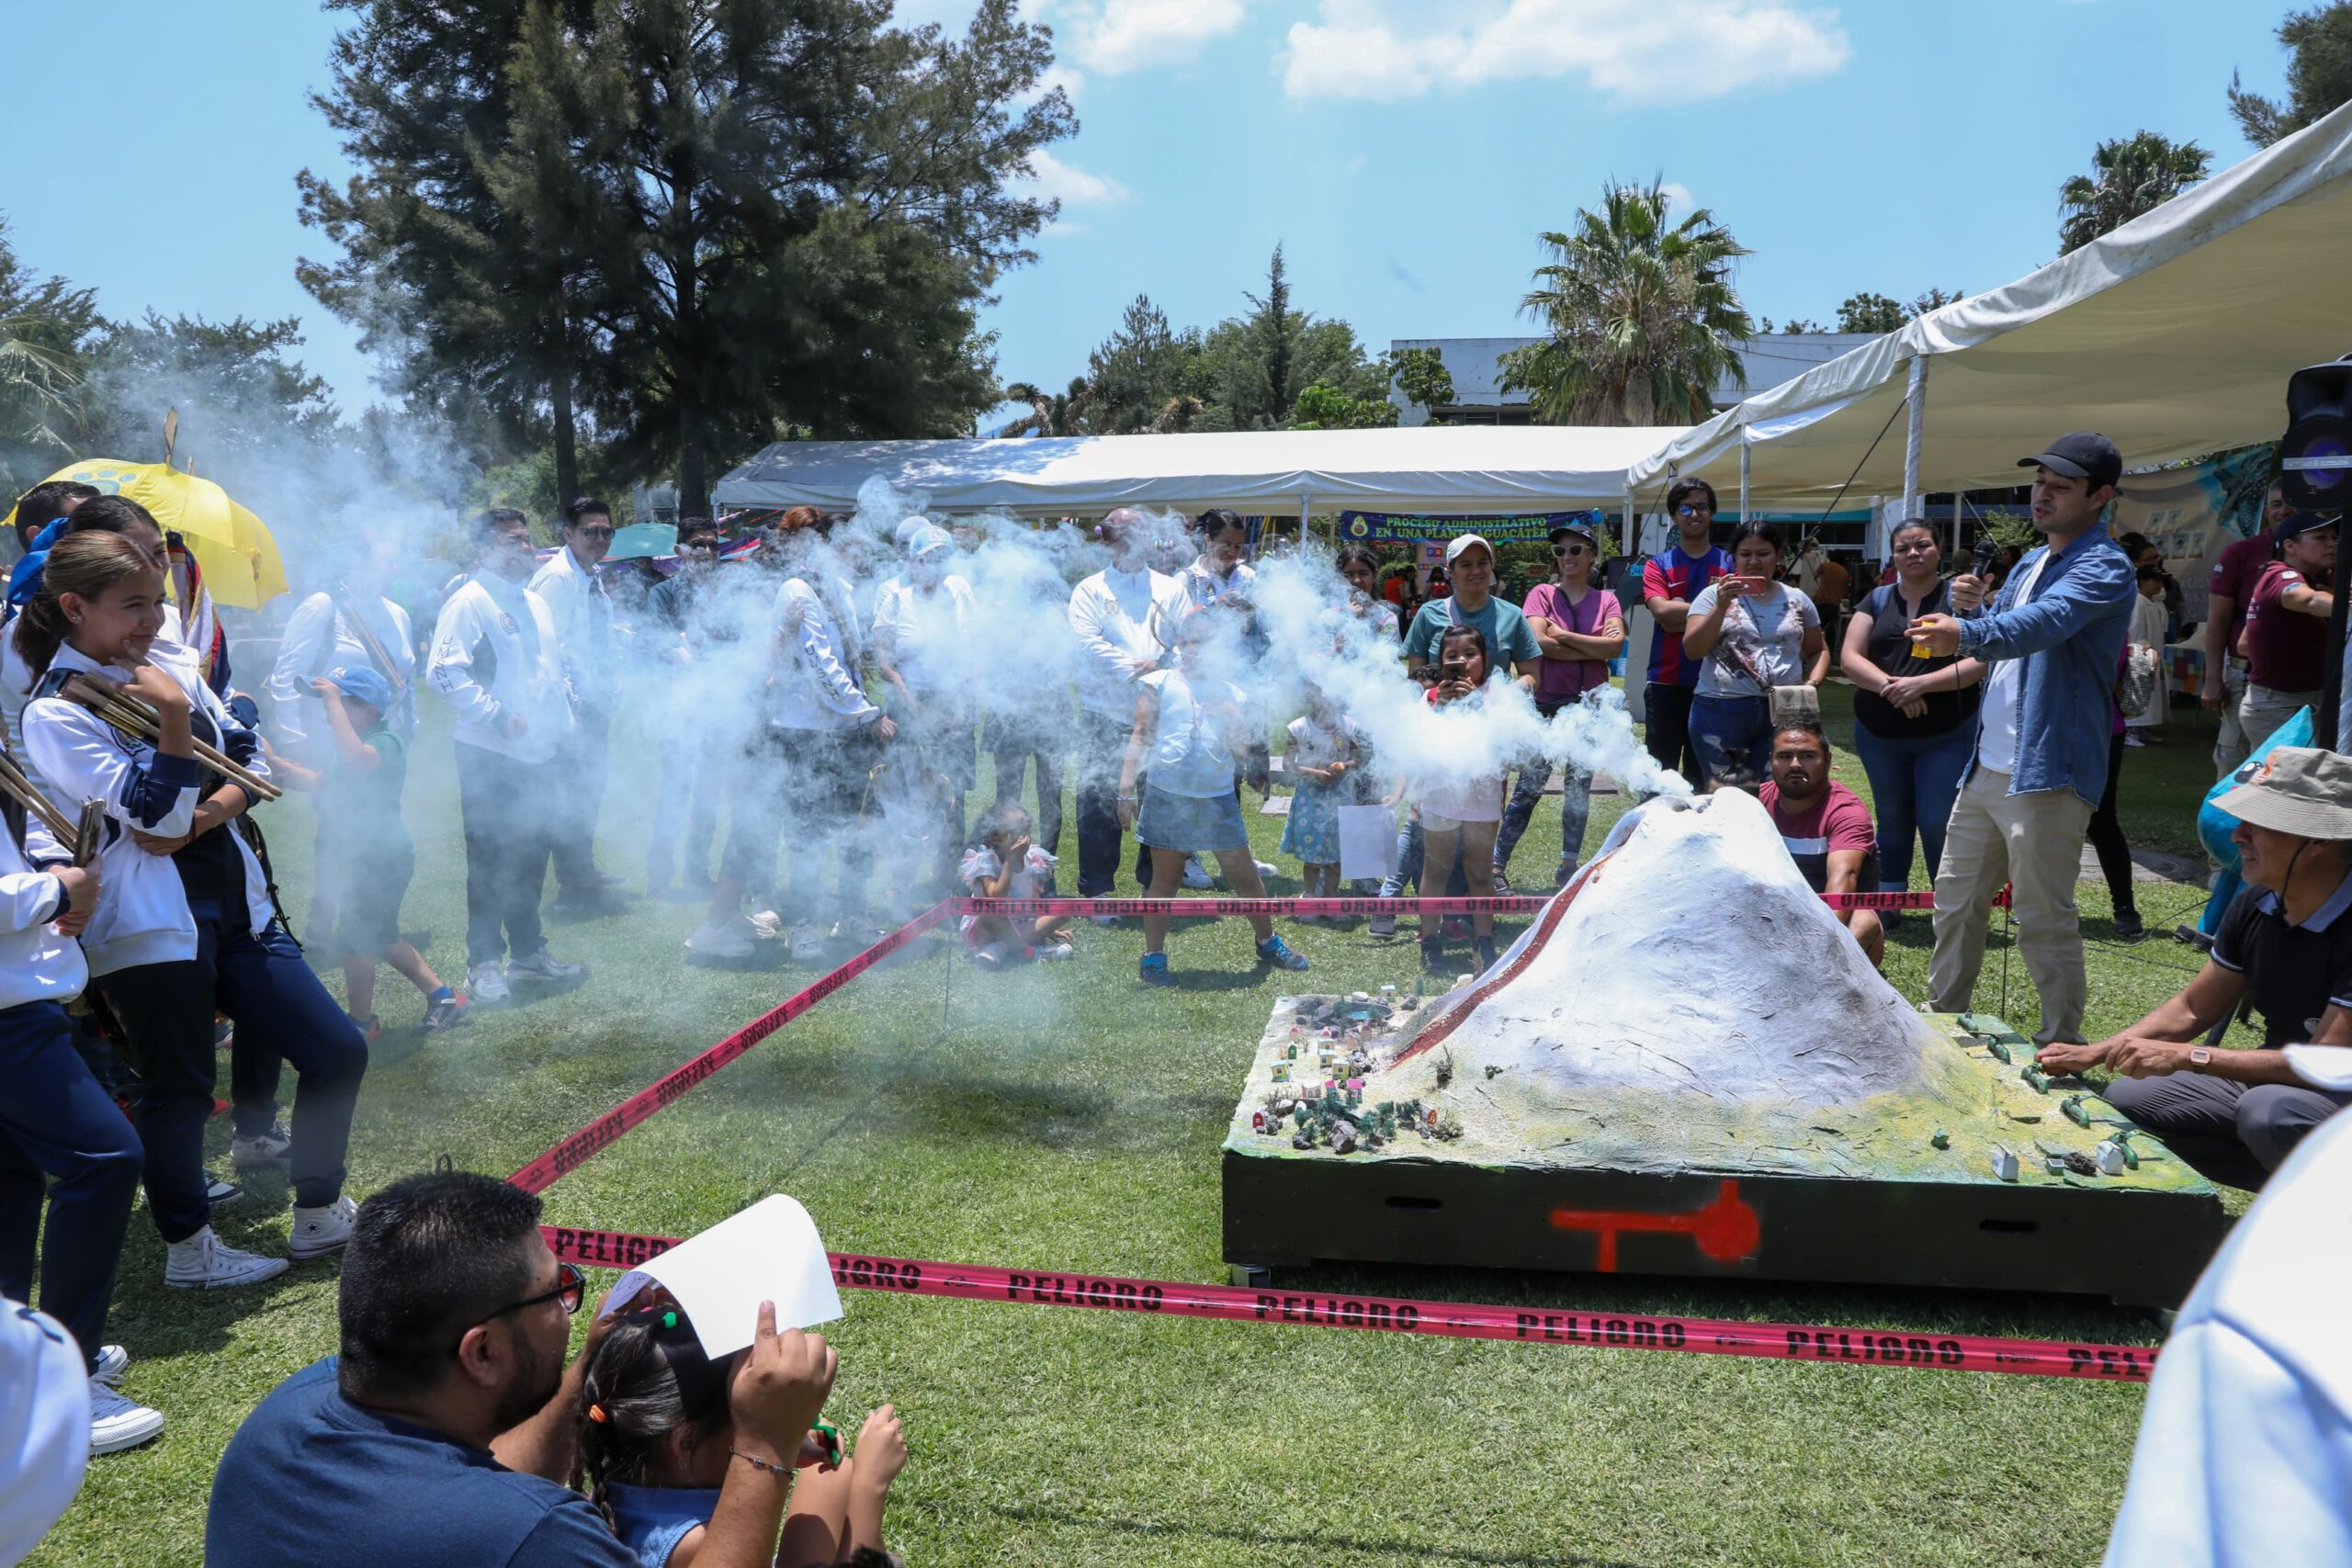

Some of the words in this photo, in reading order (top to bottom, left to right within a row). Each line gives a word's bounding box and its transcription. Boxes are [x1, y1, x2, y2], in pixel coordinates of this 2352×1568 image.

[1386, 517, 1441, 527] PROCESO
[1442, 517, 1547, 527] ADMINISTRATIVO
[1375, 527, 1392, 537] EN
[1396, 527, 1423, 537] UNA
[1425, 528, 1471, 538] PLANT
[1476, 527, 1554, 538] AGUACATER
[555, 1228, 684, 1266] PELIGR
[1007, 1273, 1164, 1312] PELIGRO
[1256, 1294, 1419, 1330] PELIGRO
[1516, 1314, 1687, 1348] PELIGRO
[1786, 1330, 1966, 1365] PELIGRO
